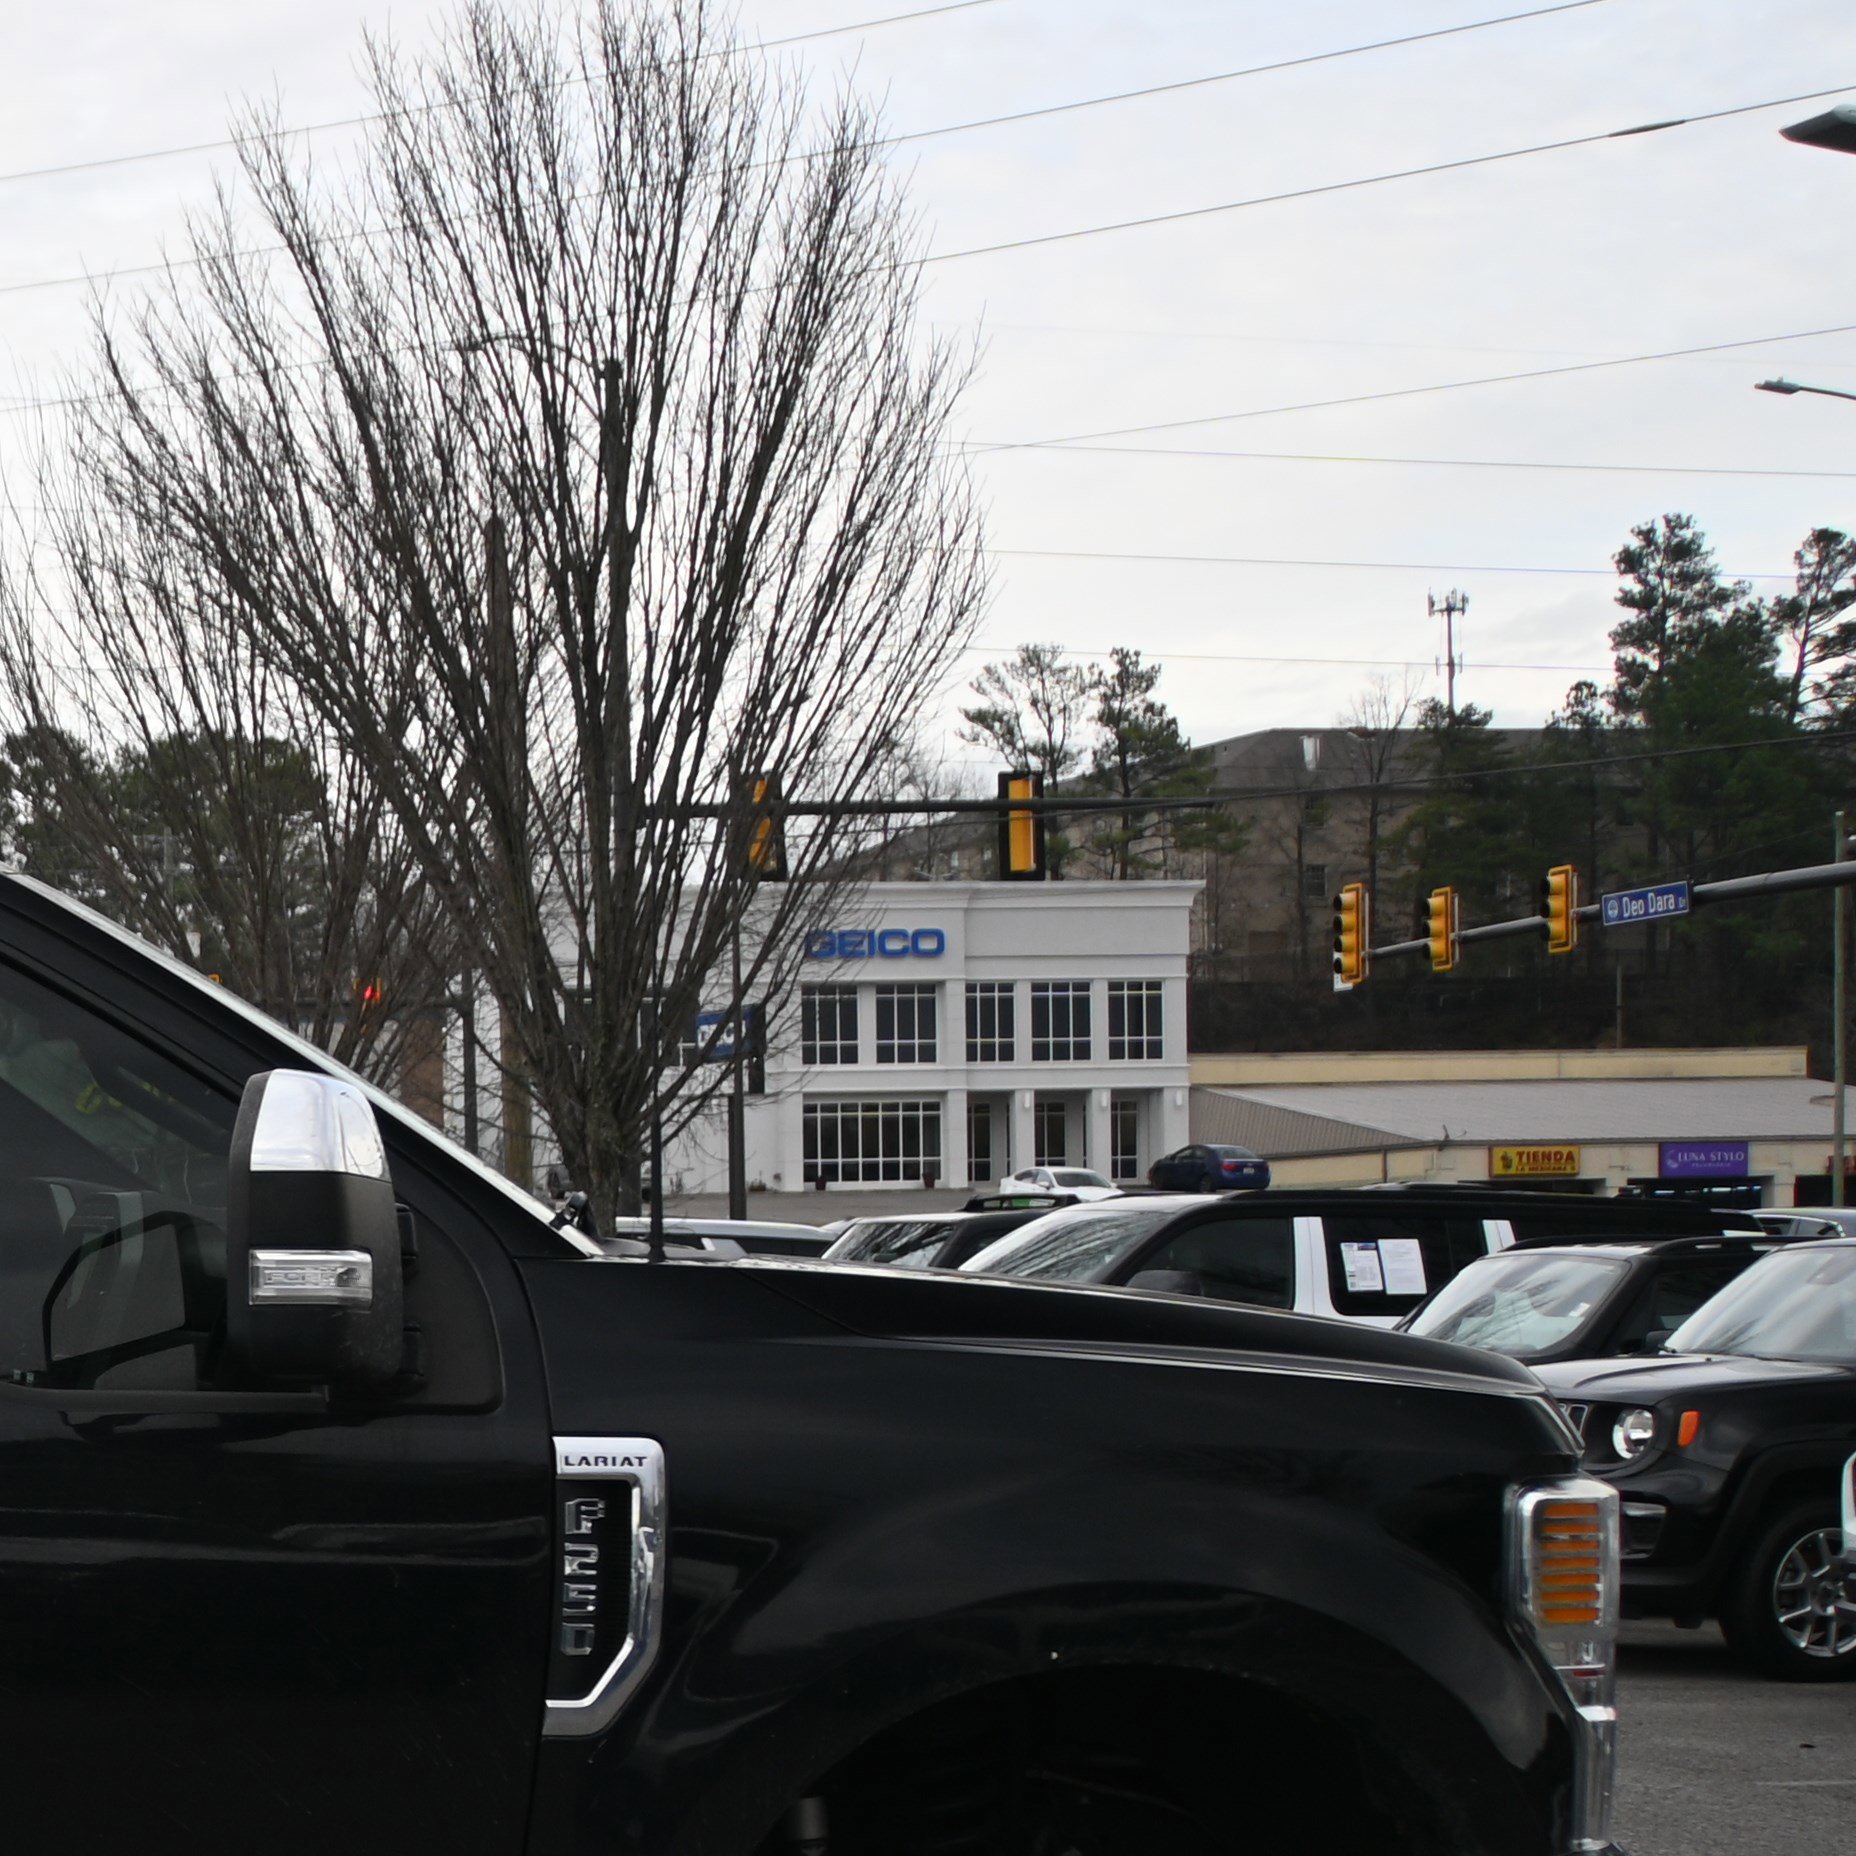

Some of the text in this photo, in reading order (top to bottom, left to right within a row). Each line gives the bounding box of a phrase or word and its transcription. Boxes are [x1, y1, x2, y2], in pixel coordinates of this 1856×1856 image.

[1622, 896, 1645, 918] Deo
[1648, 892, 1675, 914] Dara
[806, 927, 945, 959] GEICO
[1516, 1150, 1576, 1163] TIENDA
[1678, 1150, 1745, 1162] LUNA STYLO
[563, 1455, 648, 1468] LARIAT
